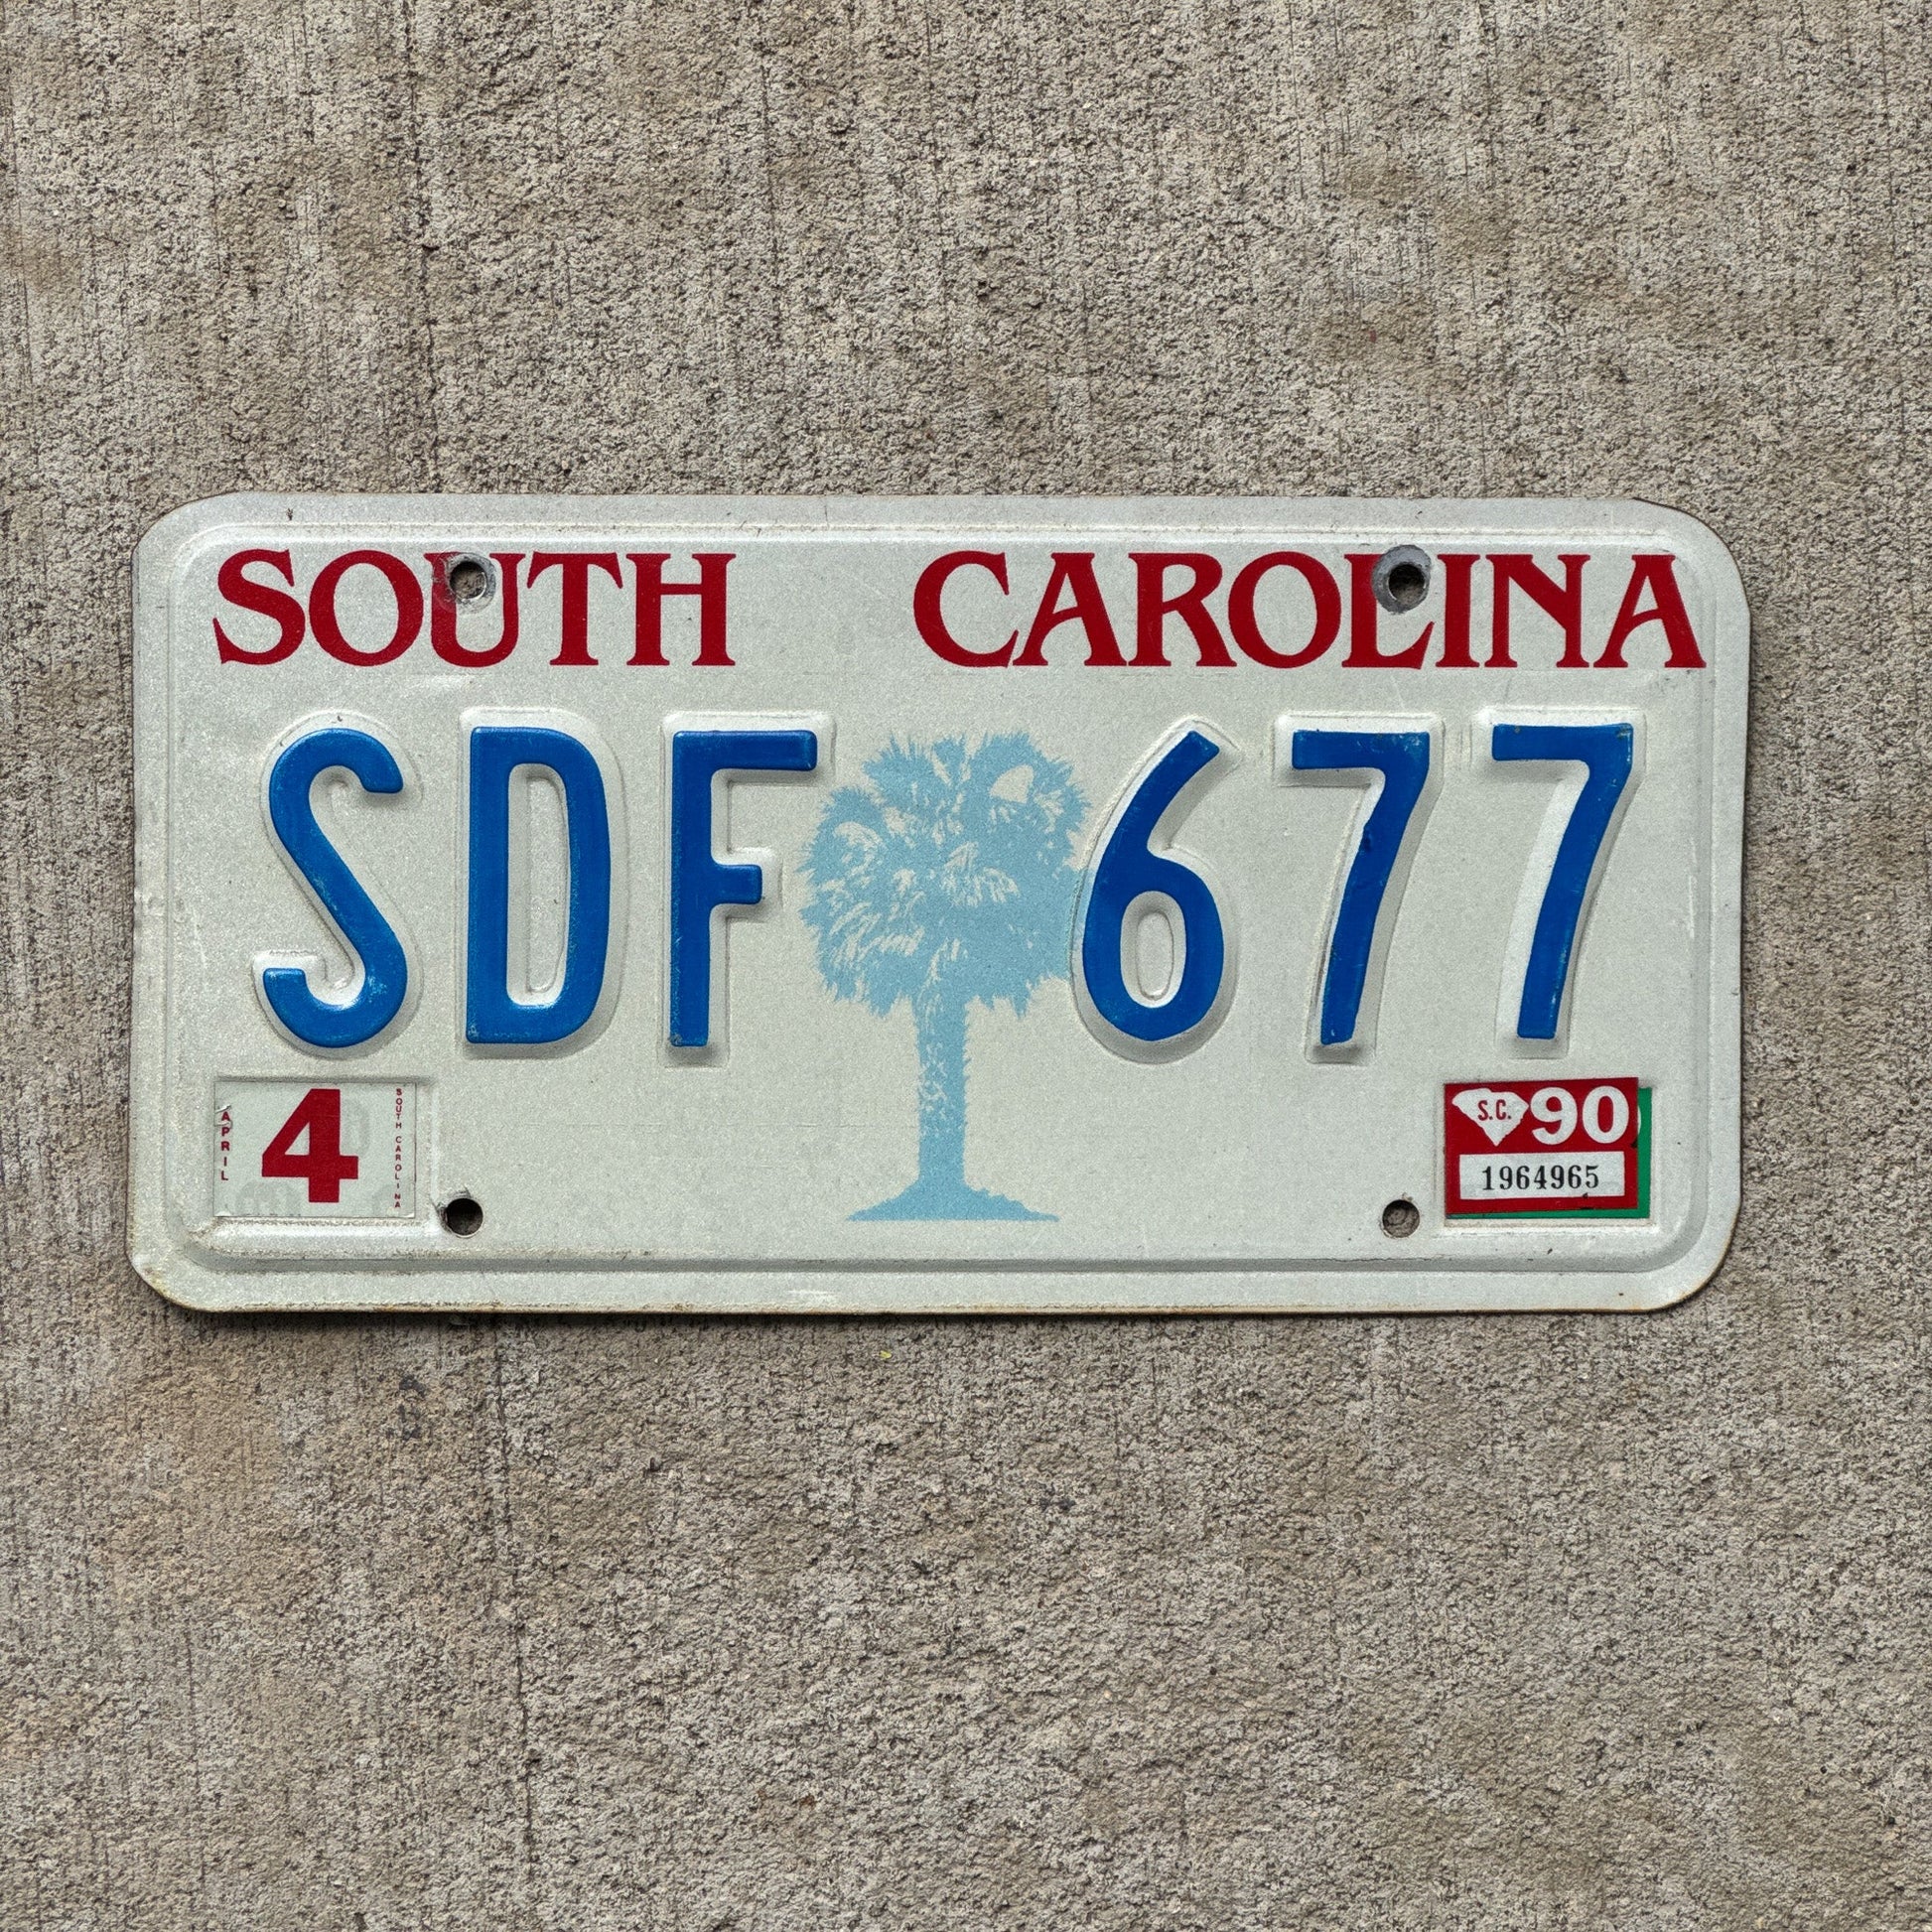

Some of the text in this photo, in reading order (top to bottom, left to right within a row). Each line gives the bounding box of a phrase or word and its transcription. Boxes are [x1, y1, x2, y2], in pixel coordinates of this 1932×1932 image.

[214, 550, 1706, 668] SOUTH CAROLINA
[264, 725, 1633, 1045] SDF 677
[394, 1088, 403, 1129] SOUTH
[1477, 1099, 1512, 1121] S.C.
[1530, 1085, 1630, 1145] 90
[220, 1111, 230, 1180] APRIL
[262, 1088, 358, 1202] 4
[1481, 1164, 1599, 1190] 1964965
